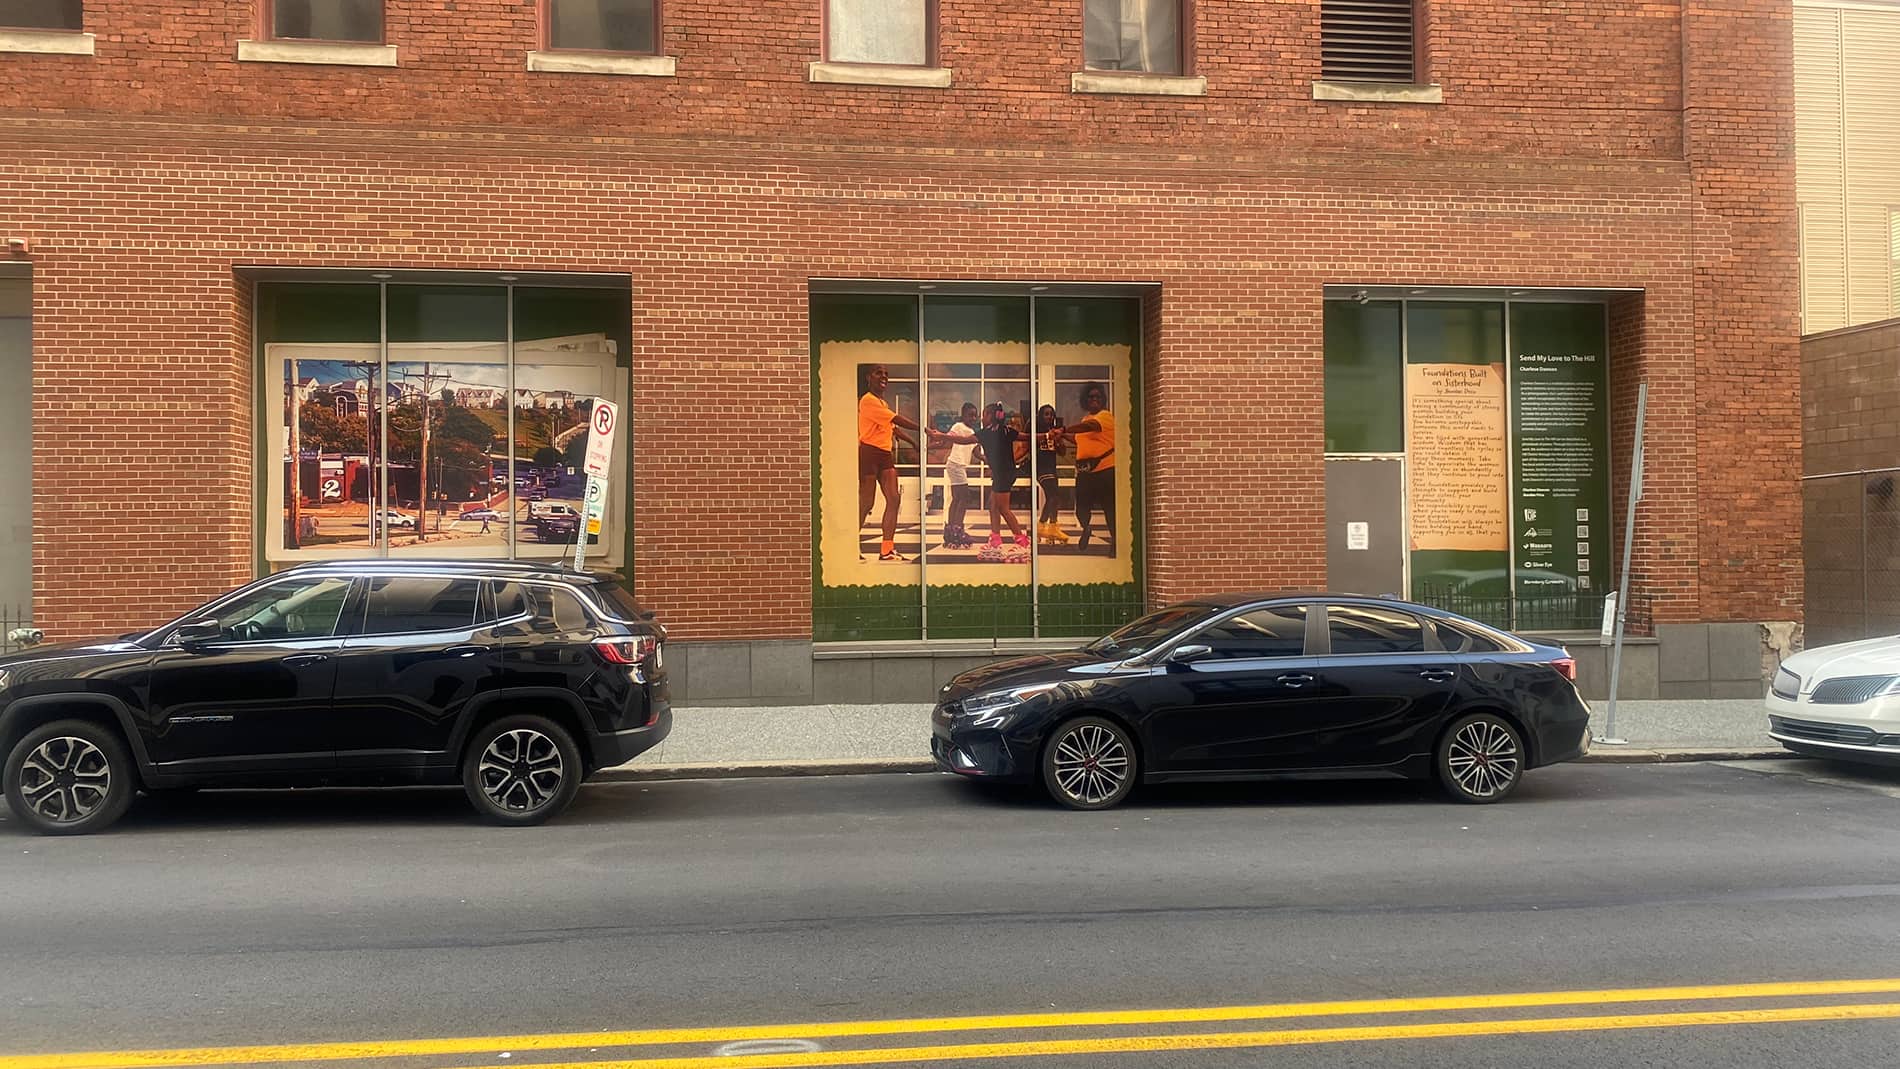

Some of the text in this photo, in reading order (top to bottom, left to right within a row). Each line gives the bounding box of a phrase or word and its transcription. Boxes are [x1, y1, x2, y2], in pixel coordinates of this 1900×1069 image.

[1422, 368, 1486, 378] Foundations Built
[1445, 379, 1481, 387] Sisterhood
[590, 486, 598, 498] P
